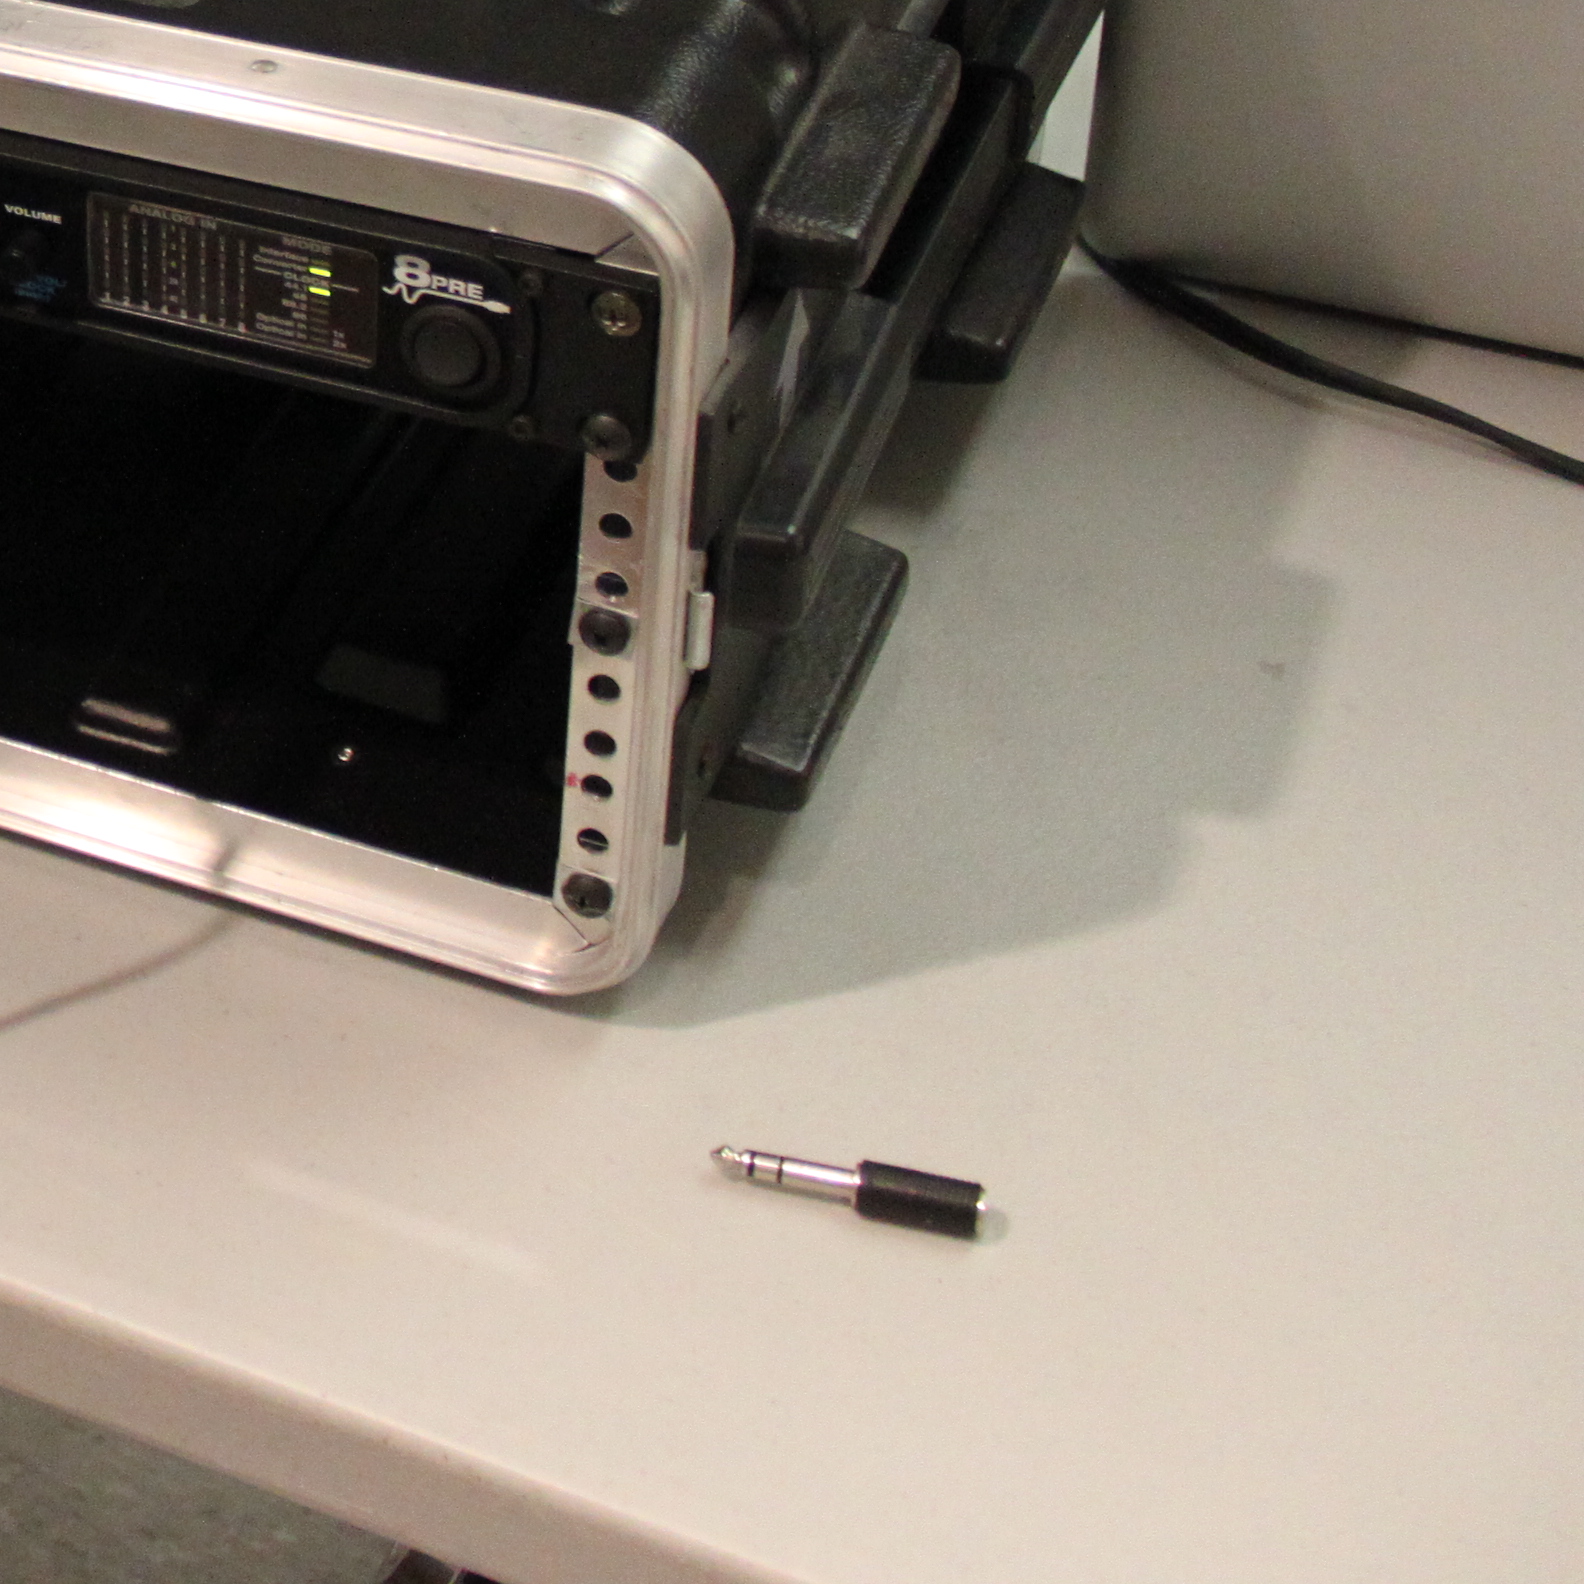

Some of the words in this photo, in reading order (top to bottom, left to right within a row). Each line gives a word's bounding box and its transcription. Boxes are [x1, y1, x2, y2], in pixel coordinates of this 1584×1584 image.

[3, 203, 63, 225] VOLUME
[128, 204, 197, 225] ANALOG
[200, 219, 217, 231] IN
[282, 236, 333, 254] MODE
[282, 271, 332, 288] CLOCK
